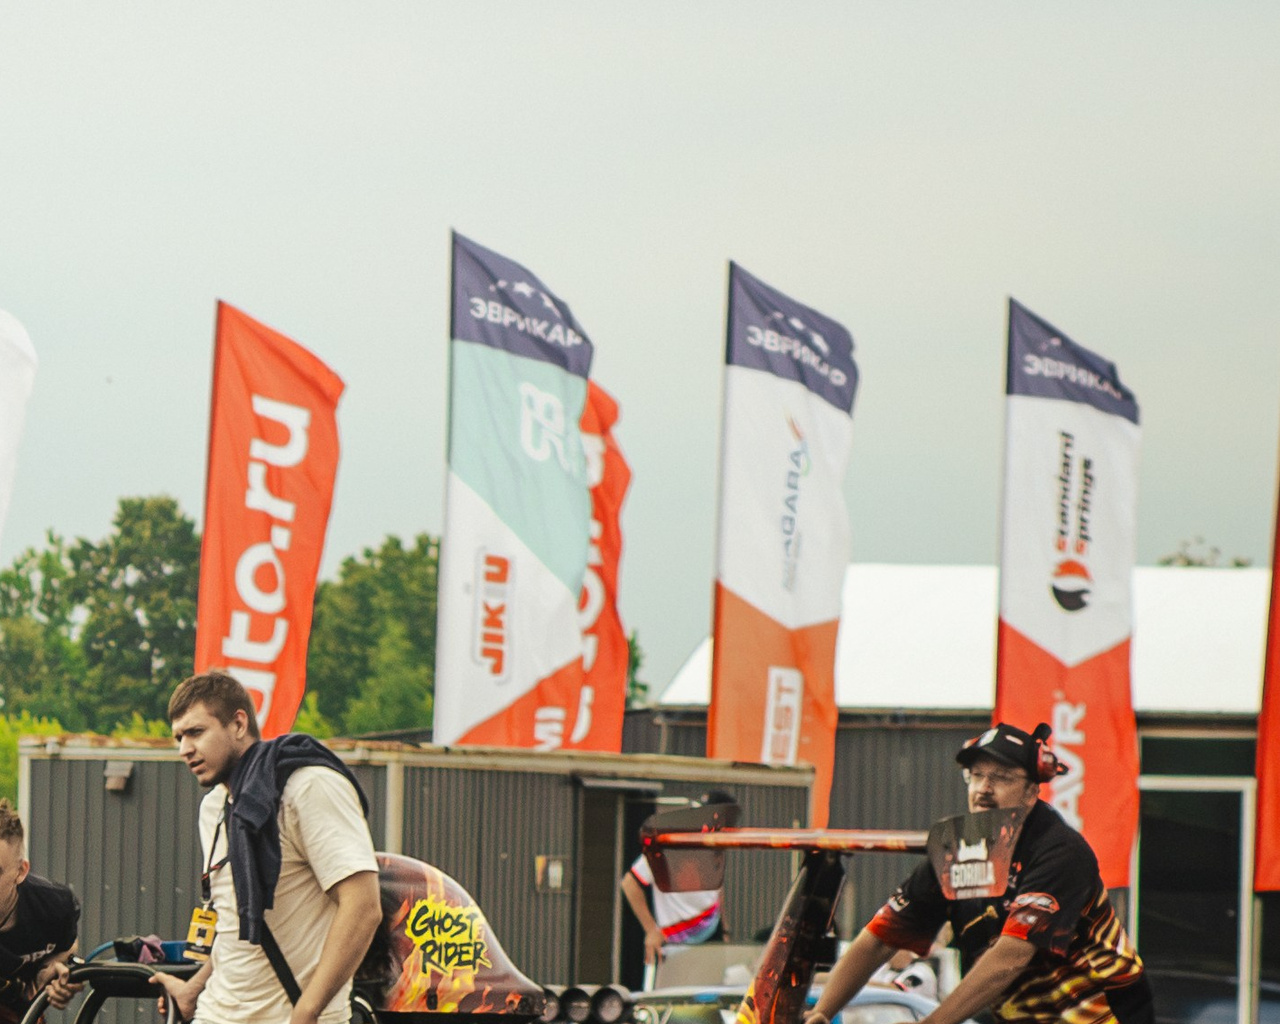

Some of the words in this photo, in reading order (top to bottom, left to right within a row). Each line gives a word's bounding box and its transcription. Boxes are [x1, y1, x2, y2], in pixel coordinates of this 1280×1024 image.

[222, 393, 311, 731] uto.ru
[1051, 702, 1086, 833] AVR
[950, 861, 996, 889] GORILLA
[411, 904, 479, 940] GHOST
[420, 940, 490, 974] RIDER
